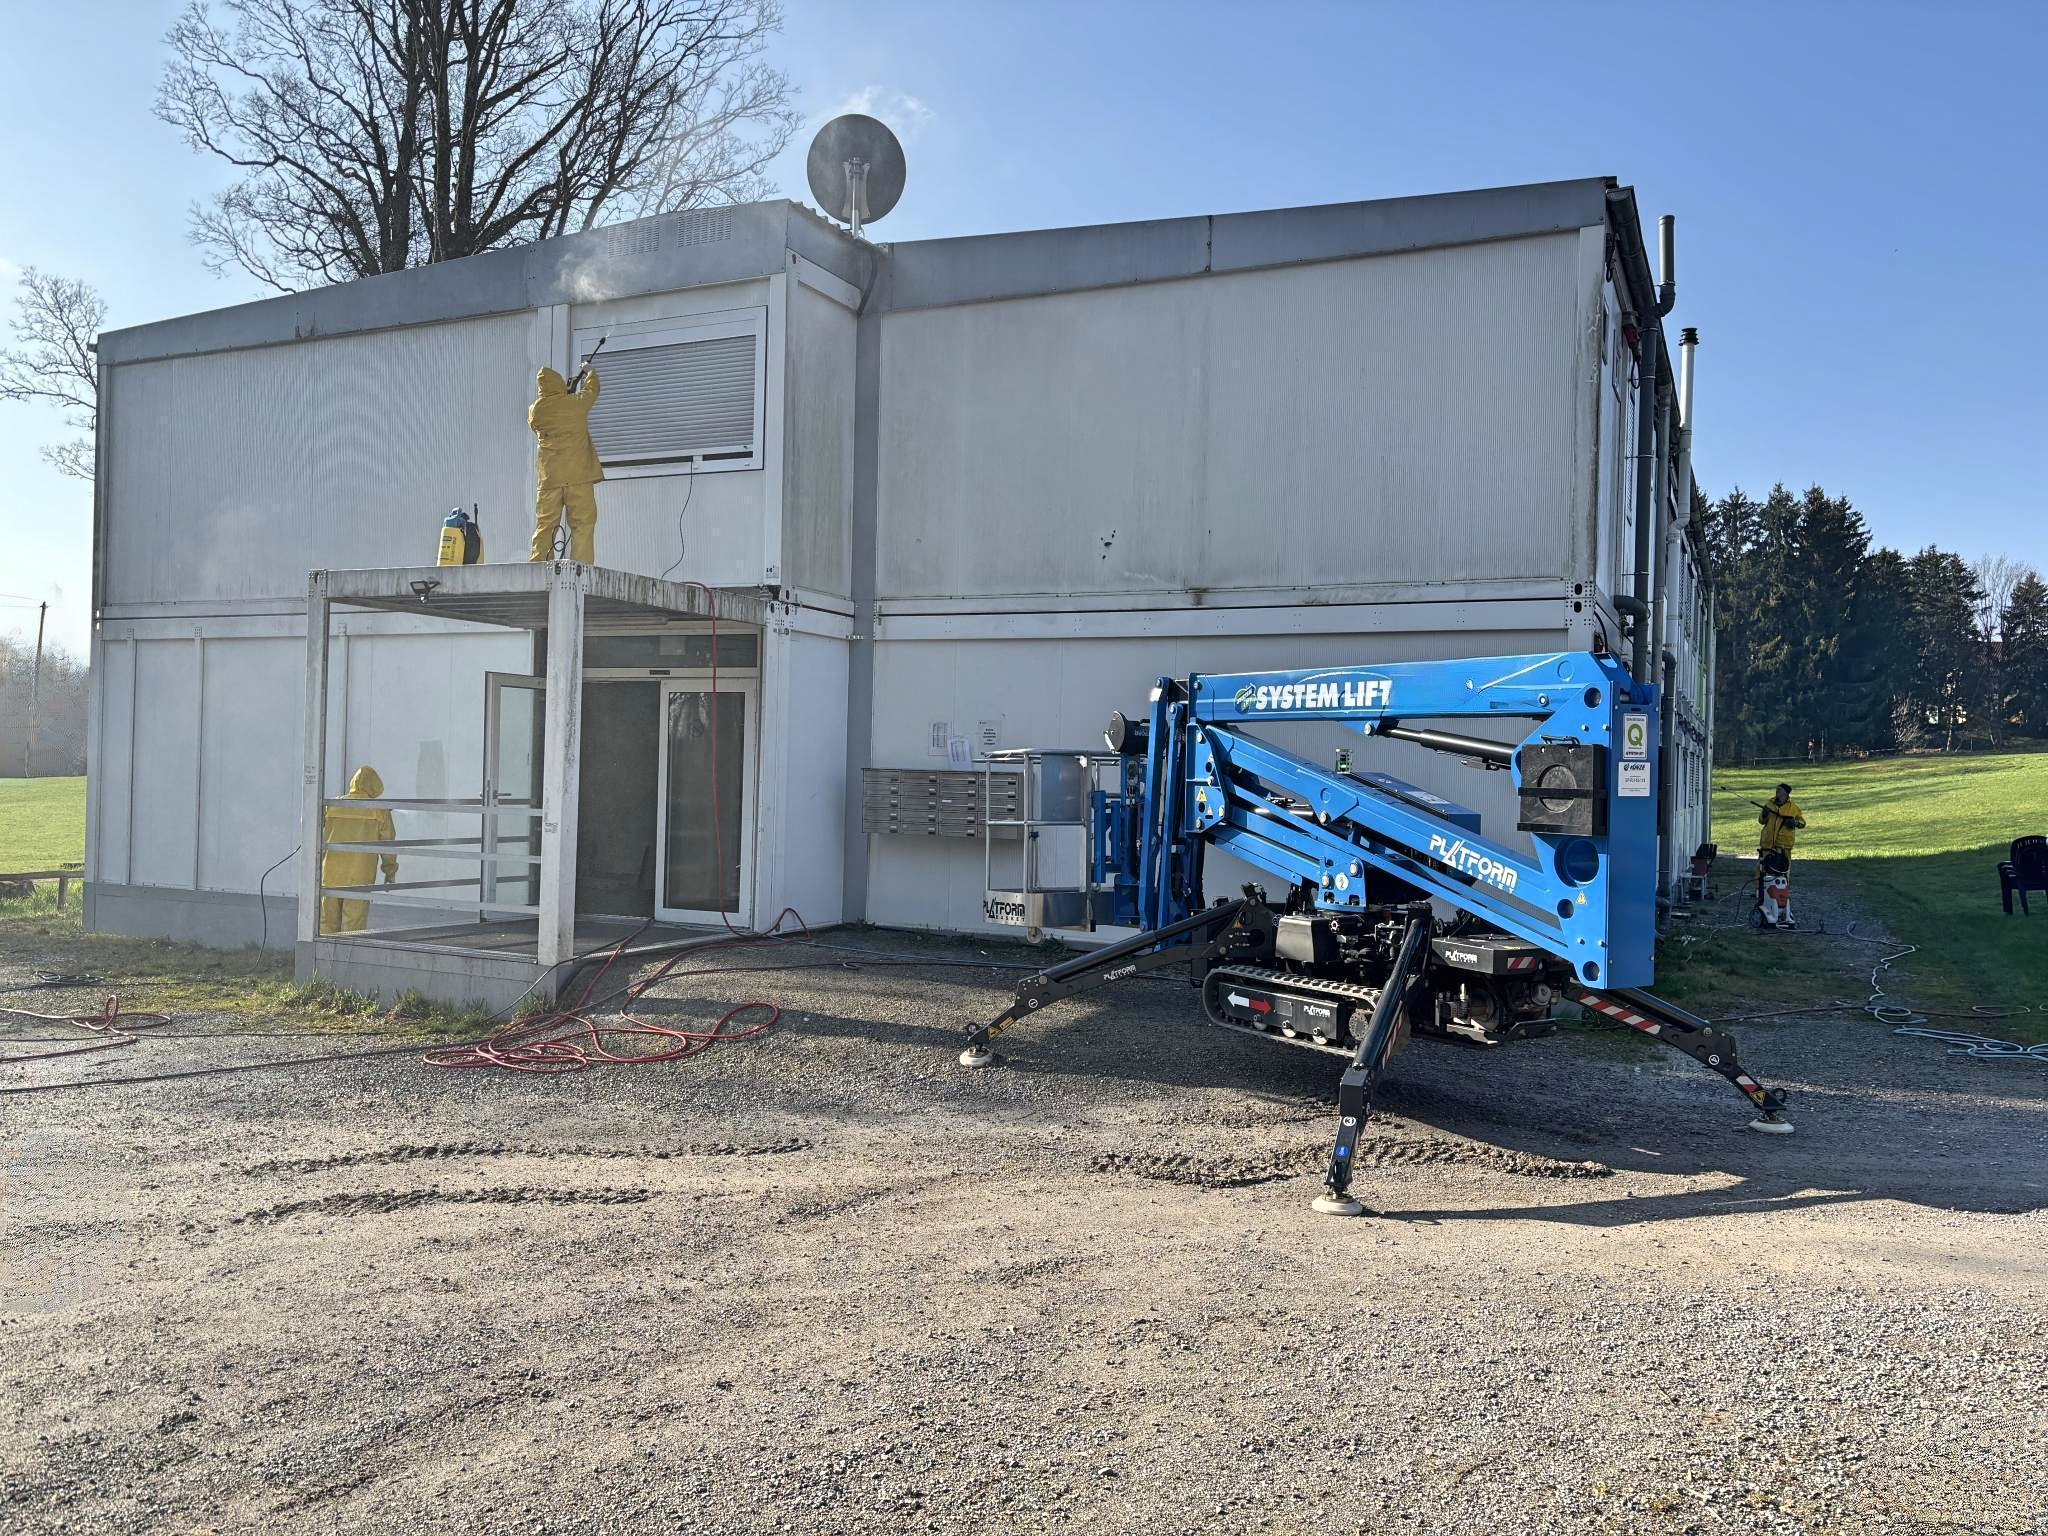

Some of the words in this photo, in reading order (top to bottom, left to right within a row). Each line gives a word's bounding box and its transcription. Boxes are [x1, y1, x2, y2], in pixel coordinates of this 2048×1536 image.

[1255, 682, 1339, 710] SYSTEM
[1344, 680, 1392, 707] LIFT
[1628, 724, 1643, 746] Q
[1429, 834, 1518, 888] PLATFORM
[983, 897, 1026, 918] PLATFORM
